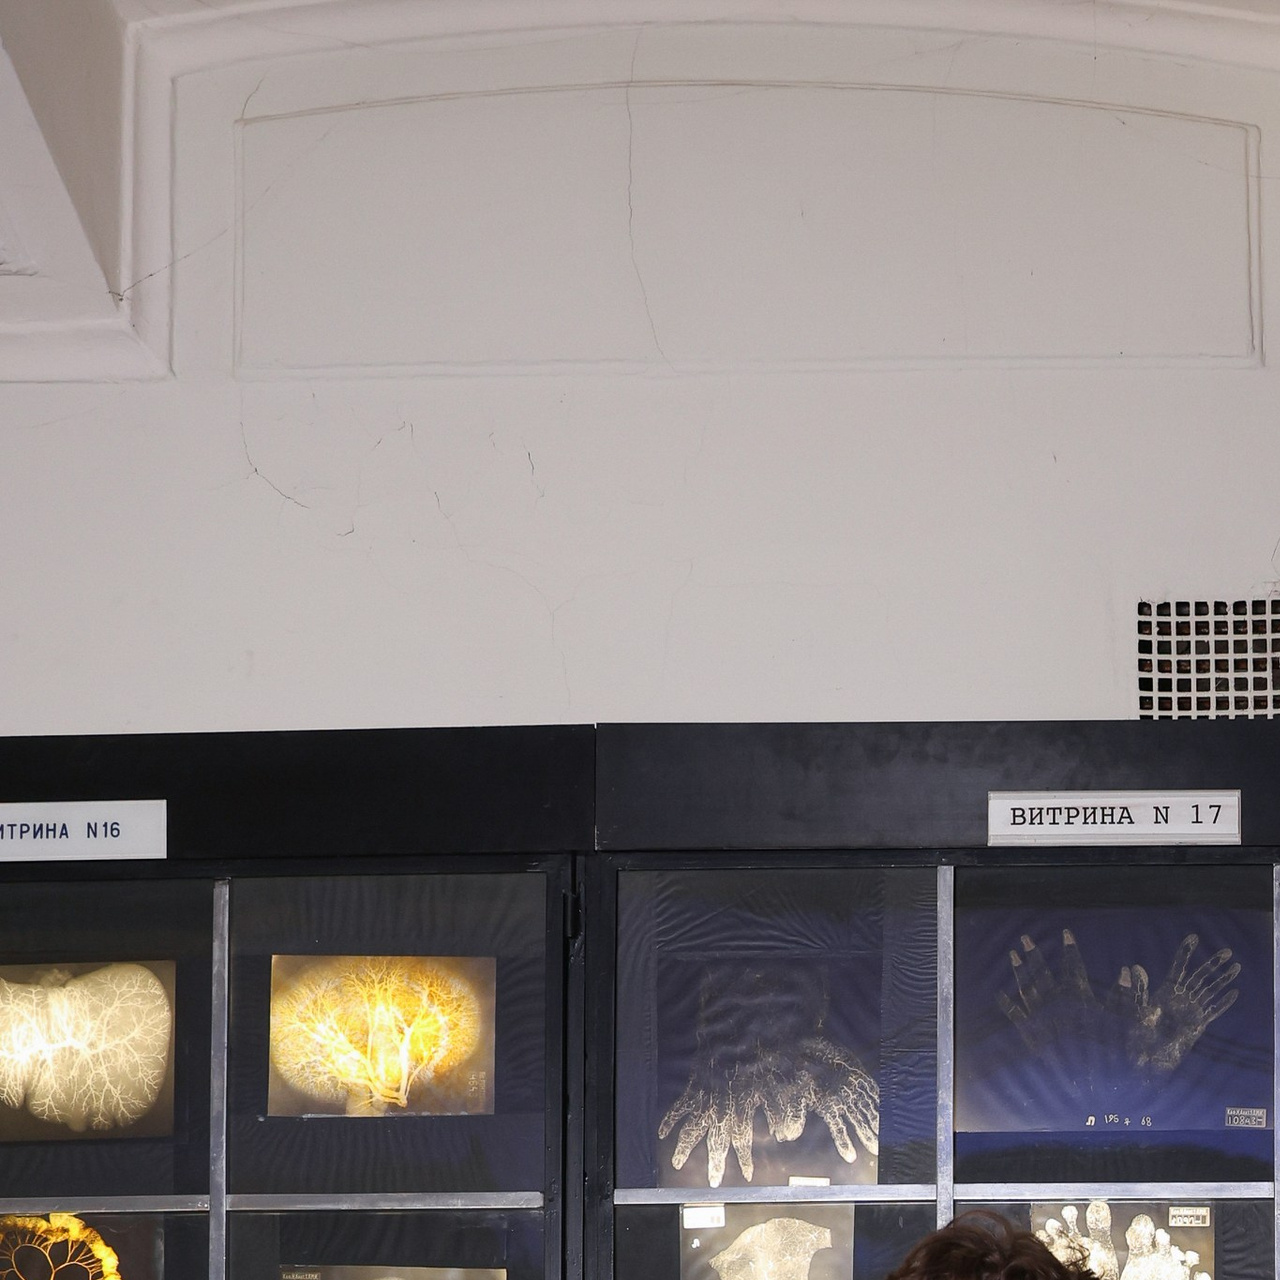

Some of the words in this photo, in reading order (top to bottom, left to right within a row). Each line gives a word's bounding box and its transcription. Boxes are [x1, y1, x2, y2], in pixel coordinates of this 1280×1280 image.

[1010, 806, 1135, 825] ВИТРИНА
[1153, 806, 1170, 824] N
[1191, 804, 1222, 824] 17
[86, 822, 120, 838] N16
